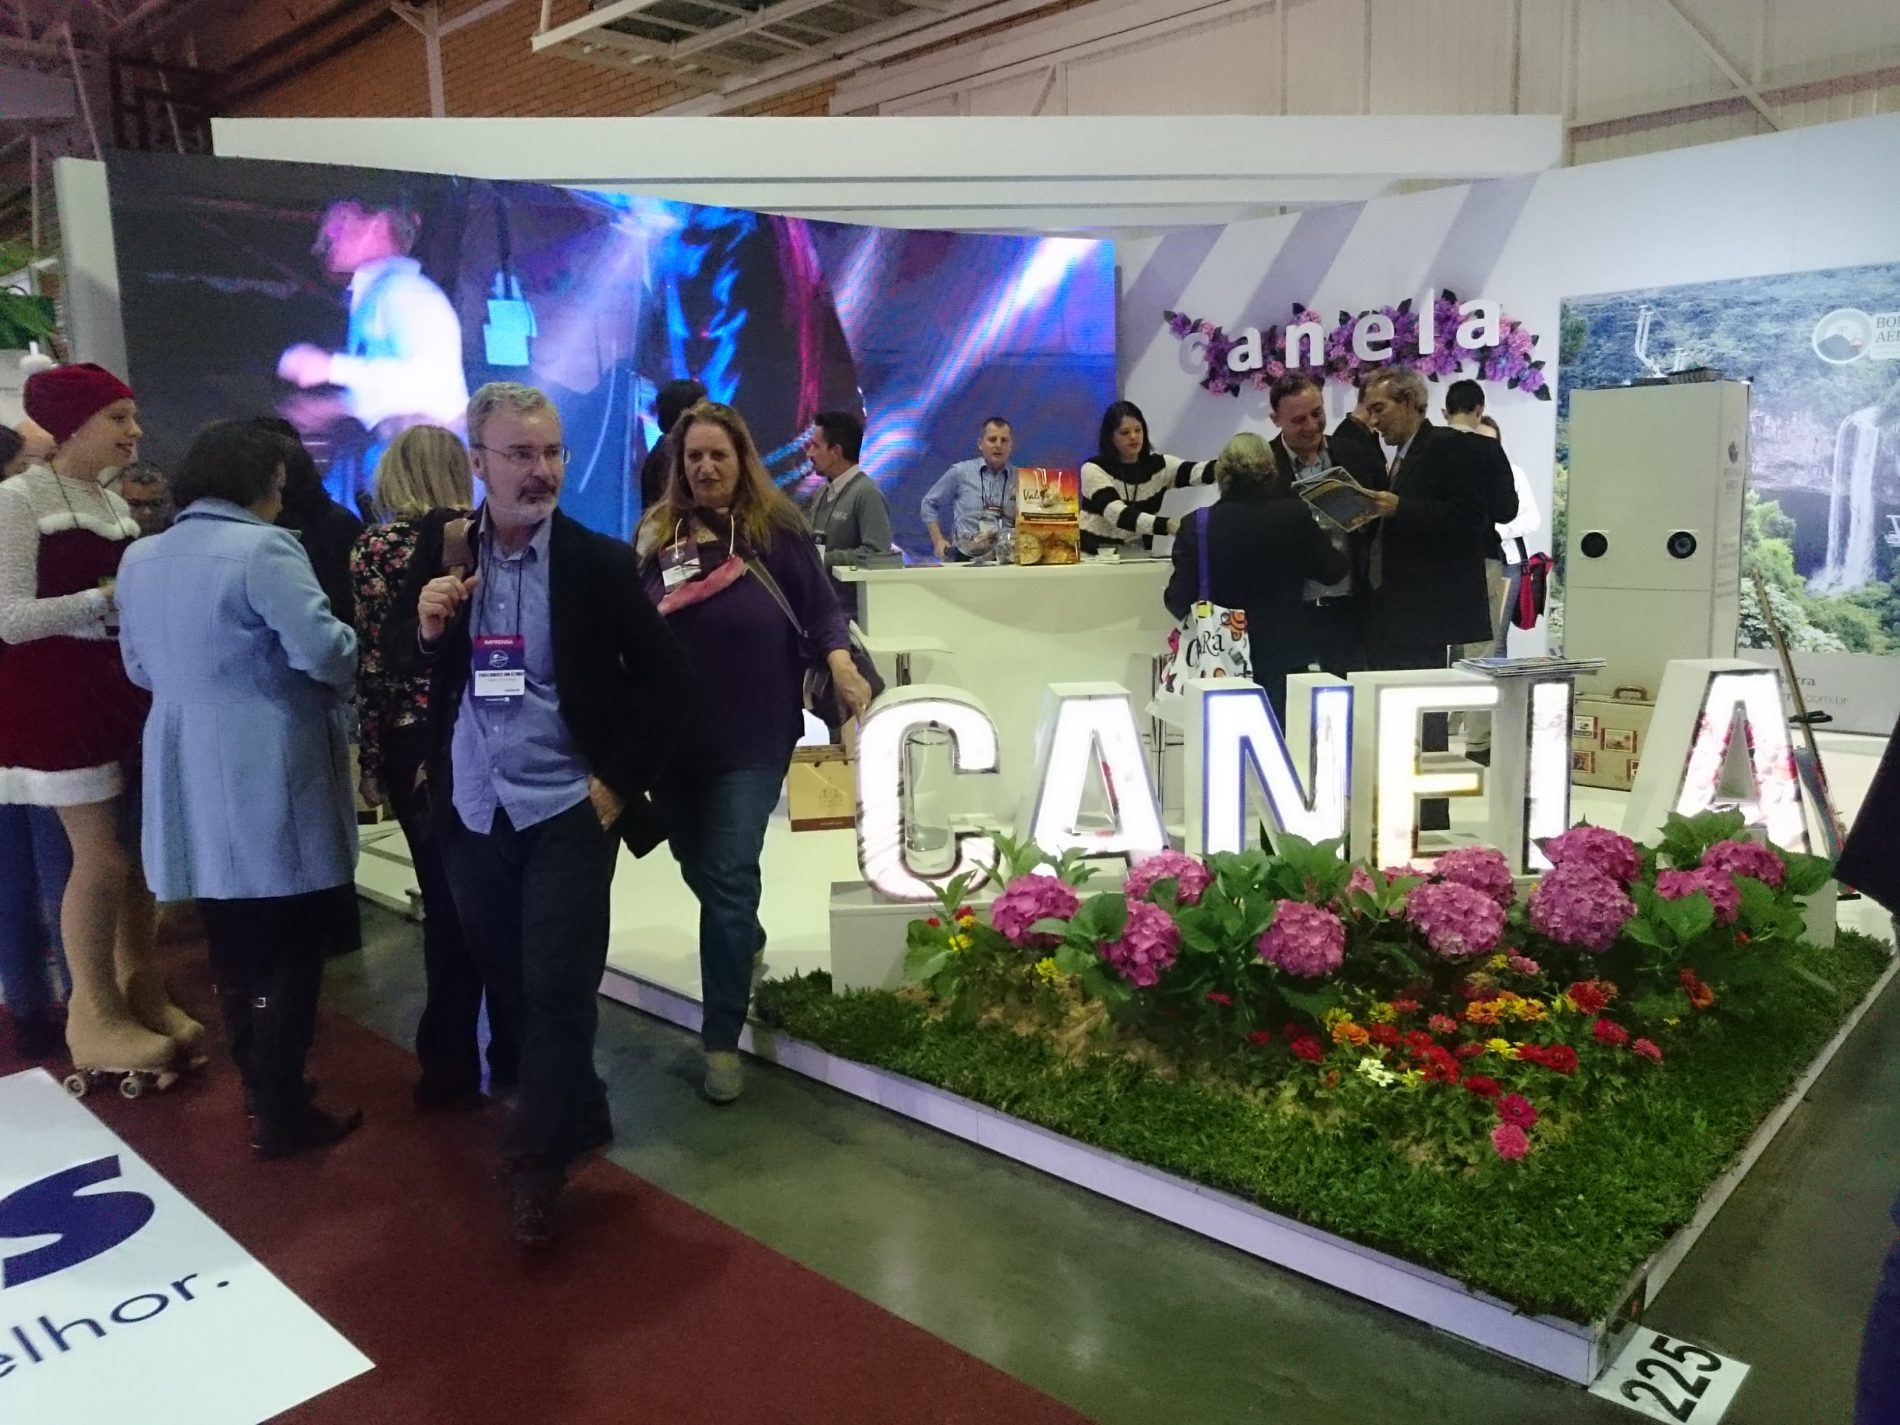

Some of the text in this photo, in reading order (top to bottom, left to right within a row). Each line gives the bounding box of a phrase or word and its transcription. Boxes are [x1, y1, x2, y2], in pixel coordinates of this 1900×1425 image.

[1178, 287, 1501, 375] canela
[1876, 315, 1900, 329] BO
[852, 662, 1815, 902] CANELA
[1619, 1333, 1723, 1424] 225
